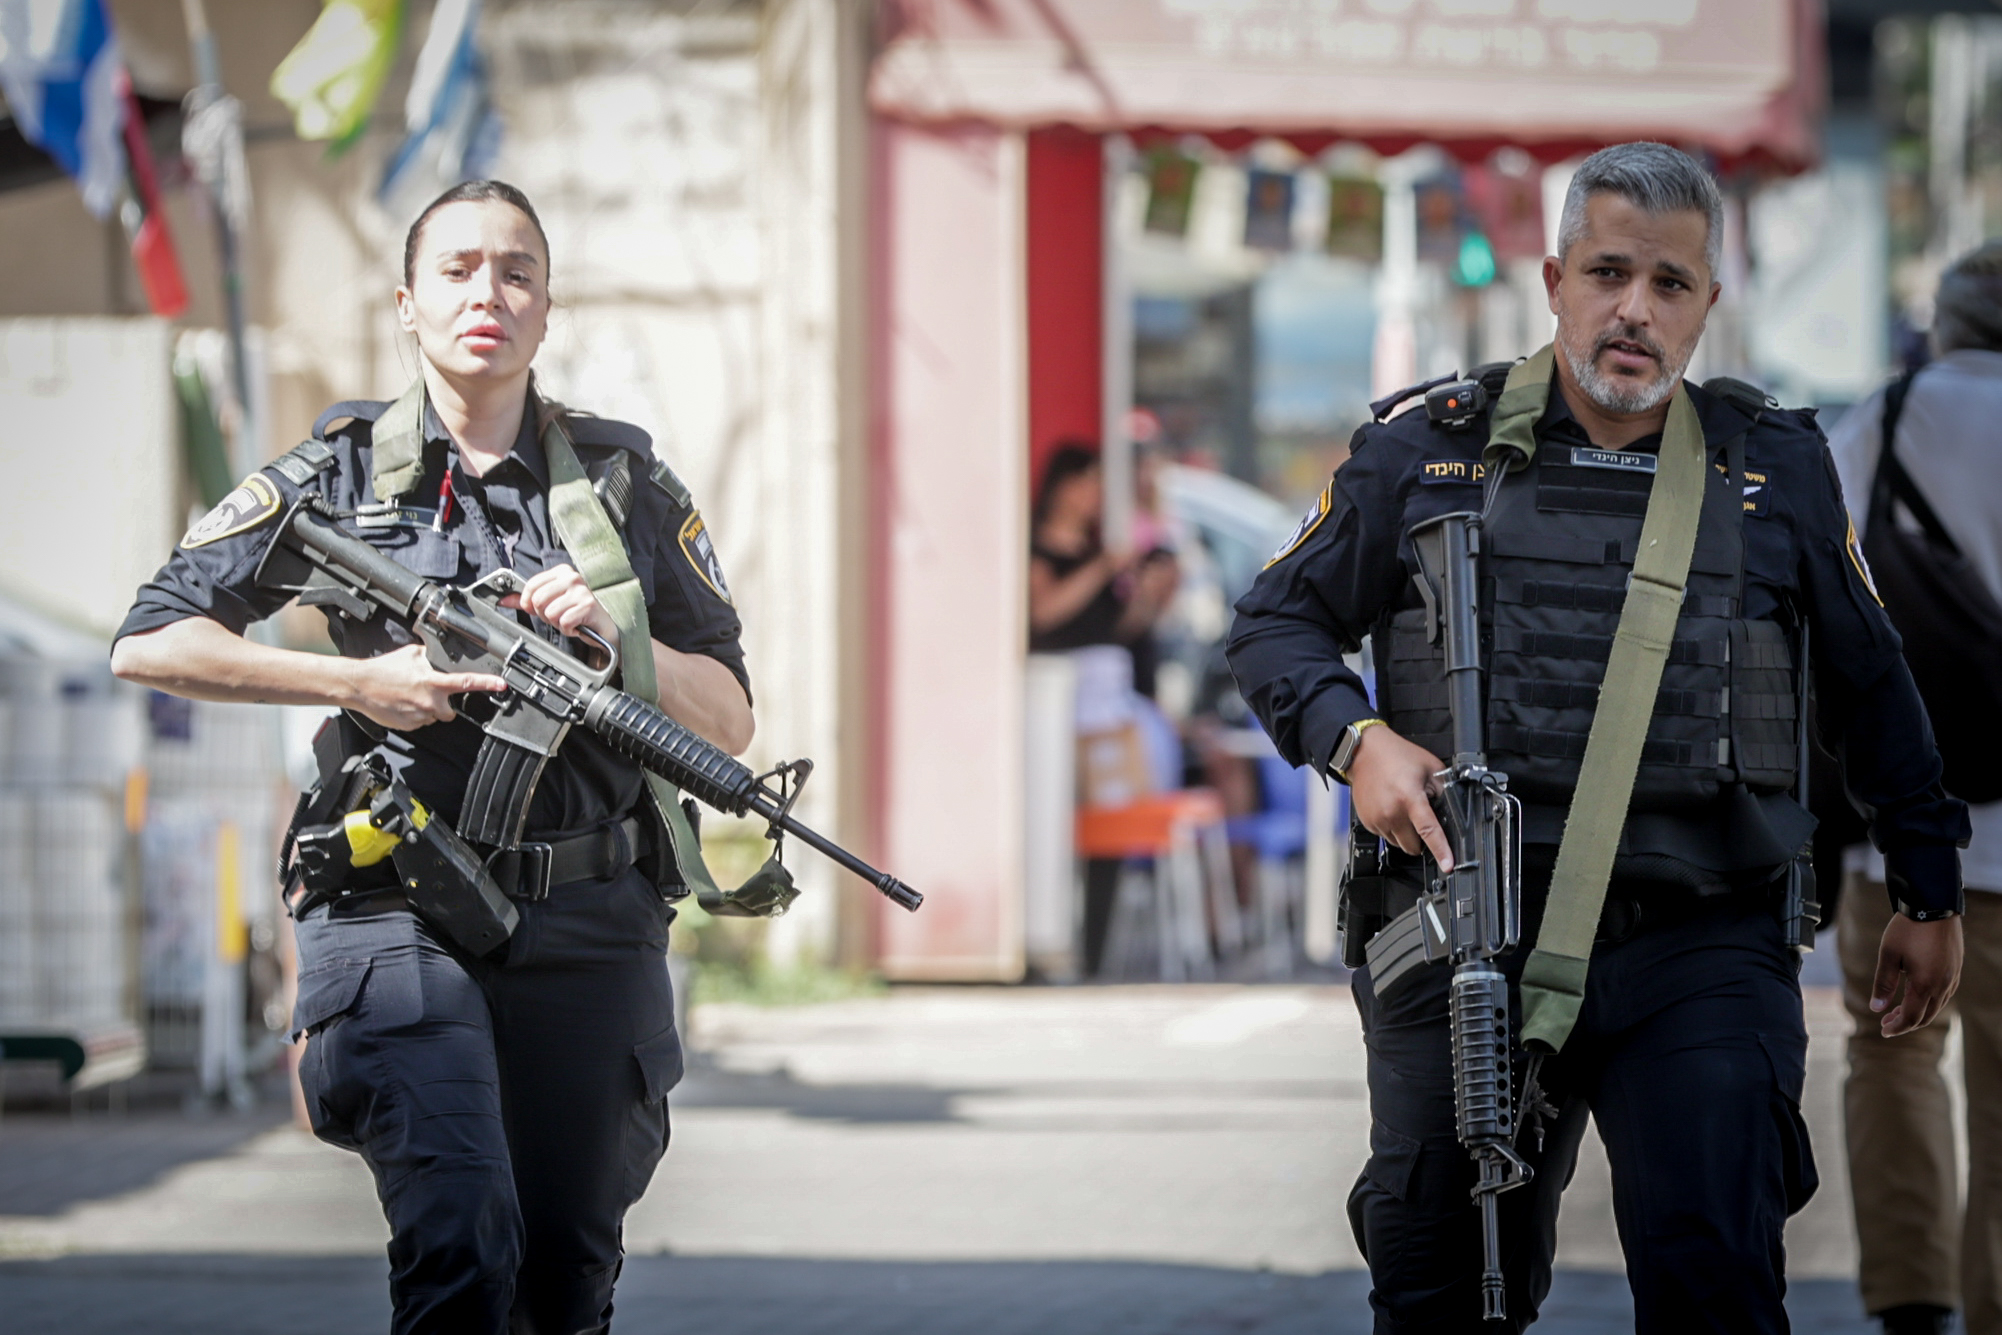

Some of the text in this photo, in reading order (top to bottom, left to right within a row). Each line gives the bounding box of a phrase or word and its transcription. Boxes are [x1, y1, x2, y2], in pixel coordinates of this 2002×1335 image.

[1621, 455, 1640, 465] ניצן
[1425, 462, 1465, 477] הינדי
[1744, 471, 1766, 483] משטר
